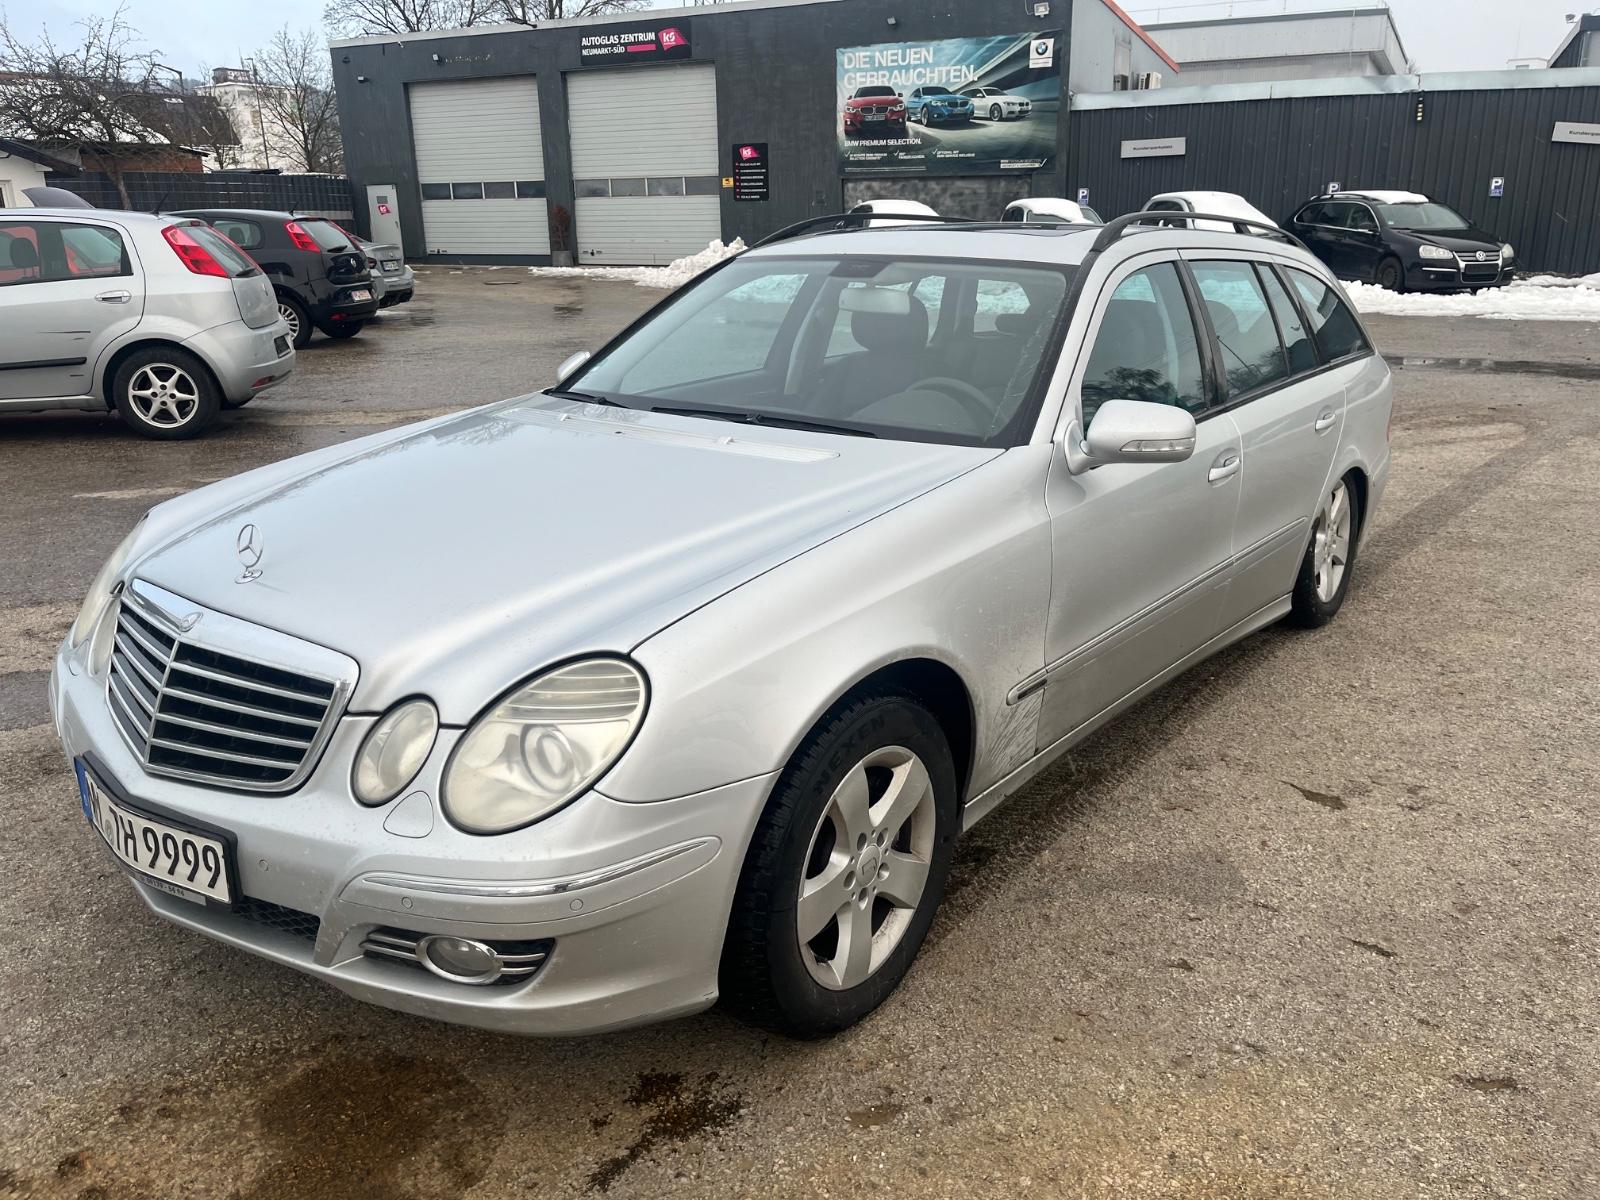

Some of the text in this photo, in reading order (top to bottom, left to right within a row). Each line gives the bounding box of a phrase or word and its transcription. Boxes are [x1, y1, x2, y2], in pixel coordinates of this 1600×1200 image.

[581, 31, 656, 47] AUTOGLAS ZENTRUM
[581, 45, 626, 56] NEUMARKT-SÜD
[843, 46, 934, 69] DIE NEUEN
[843, 64, 978, 89] GEBRAUCHTEN.
[859, 139, 886, 147] PREMIUM
[1329, 183, 1338, 194] P
[1491, 178, 1502, 190] P
[1079, 190, 1088, 199] P
[142, 826, 221, 889] 9999
